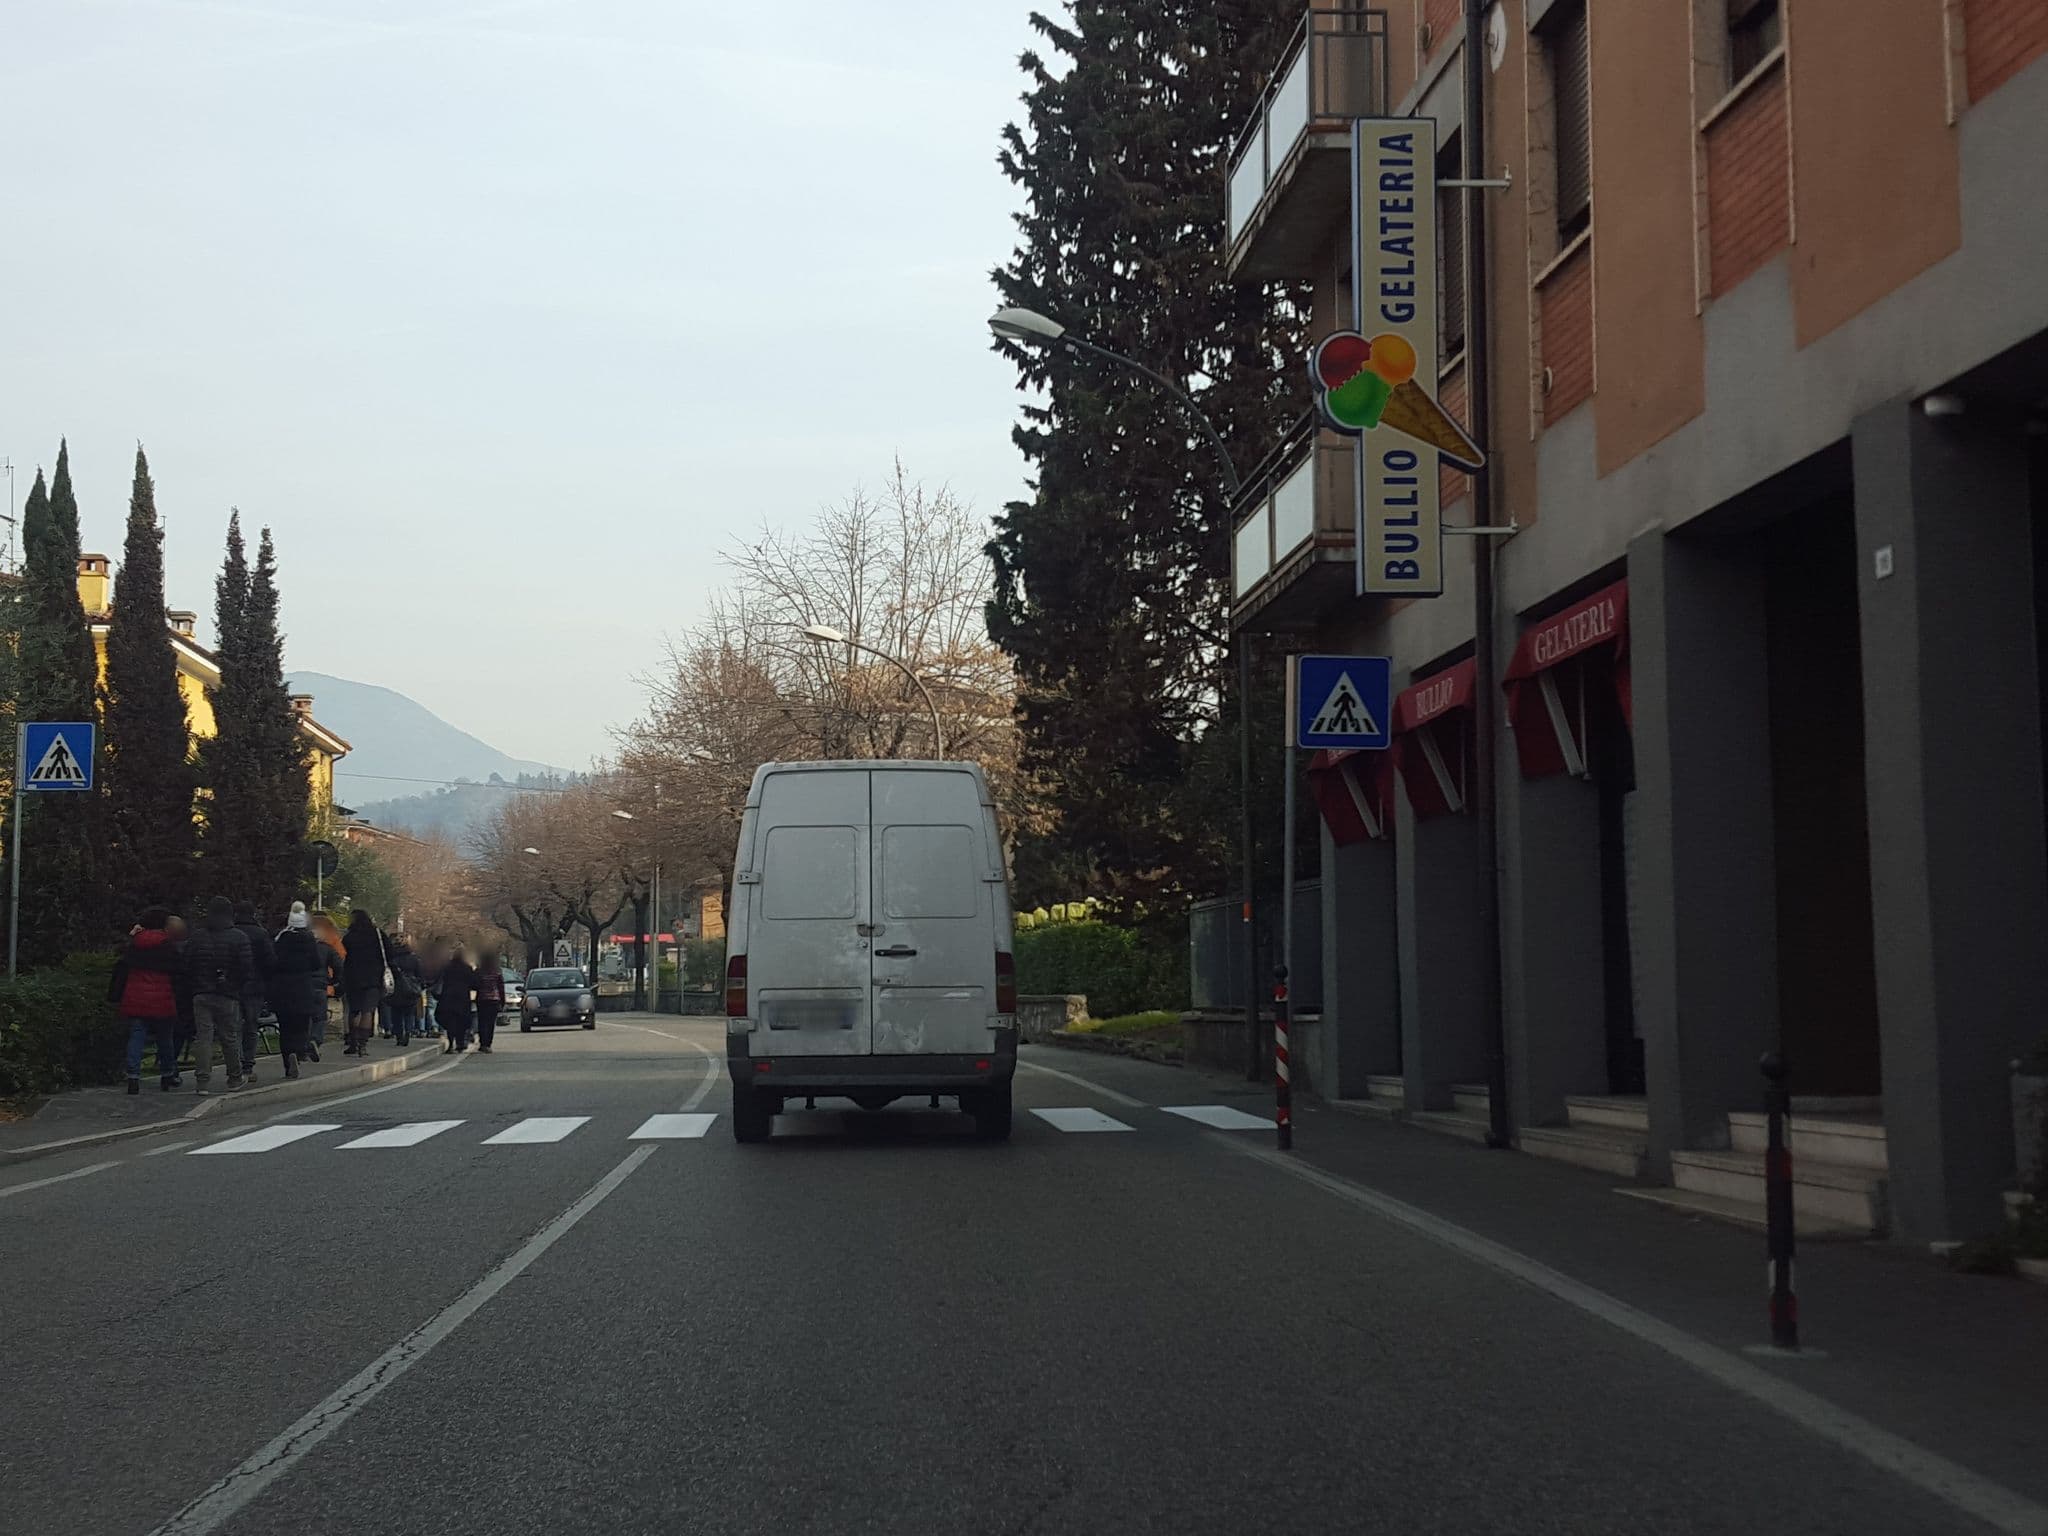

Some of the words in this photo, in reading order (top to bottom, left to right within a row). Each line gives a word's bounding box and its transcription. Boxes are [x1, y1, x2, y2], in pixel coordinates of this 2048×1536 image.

[1379, 132, 1415, 323] GELATERIA
[1384, 450, 1420, 580] BULLIO
[1535, 598, 1615, 663] GELATERIA
